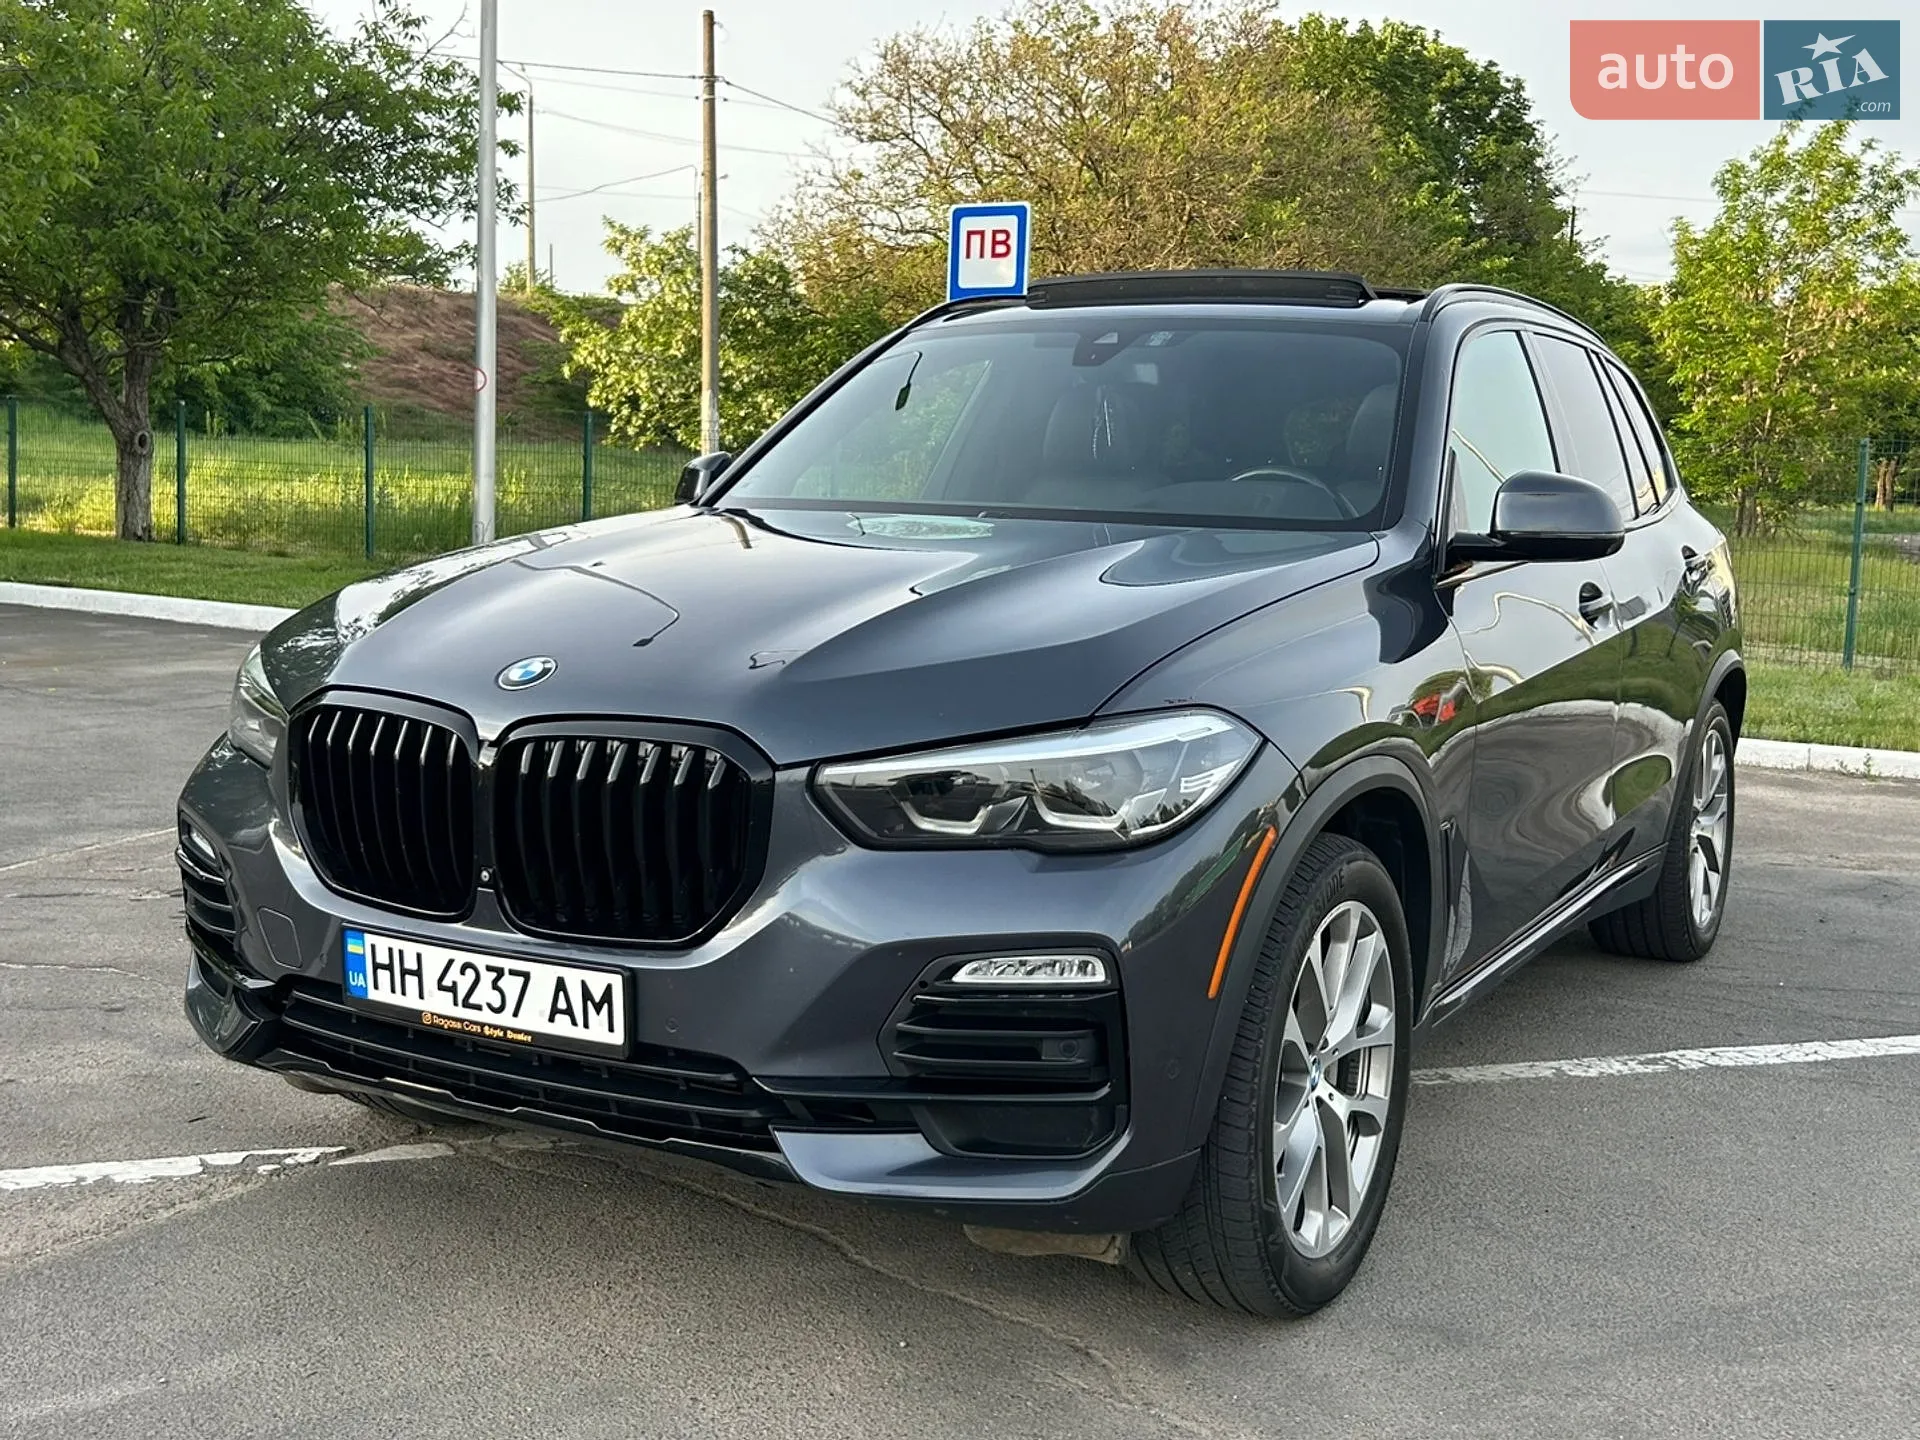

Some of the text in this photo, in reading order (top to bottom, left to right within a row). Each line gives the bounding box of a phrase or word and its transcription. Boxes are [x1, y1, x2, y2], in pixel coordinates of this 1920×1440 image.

[966, 229, 1011, 259] ПВ
[349, 971, 366, 988] UA
[370, 943, 615, 1033] HH 4237 AM
